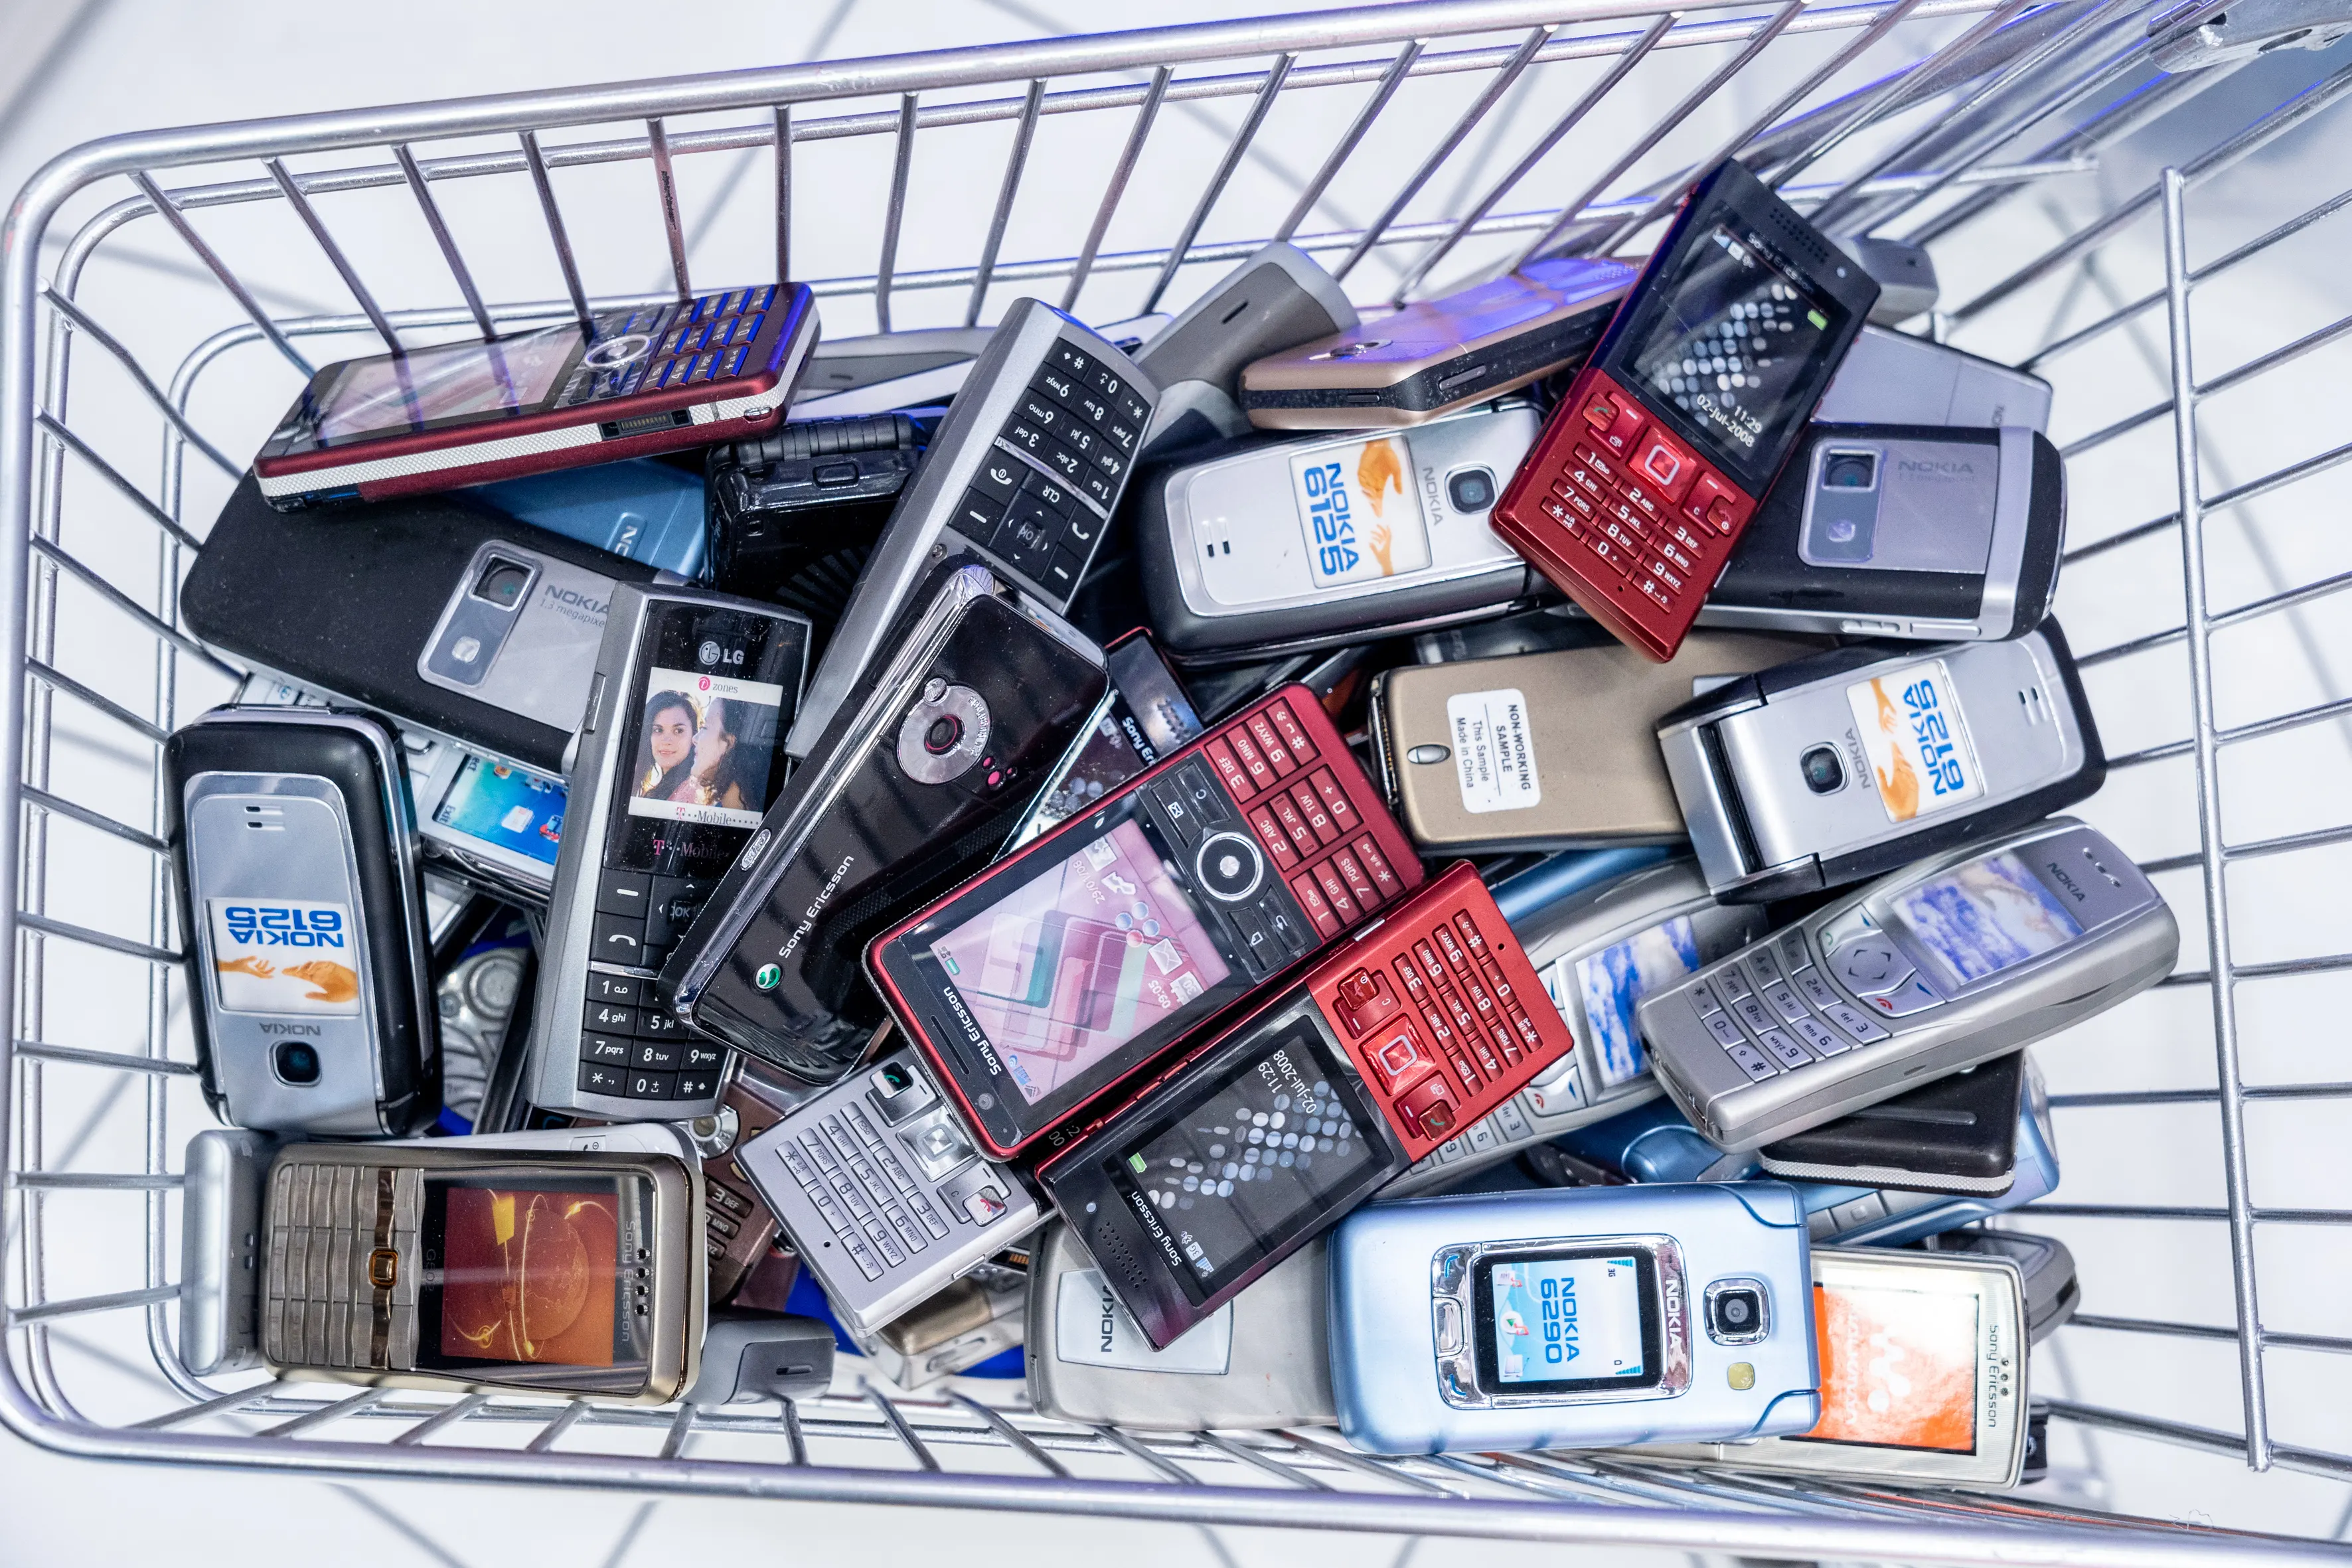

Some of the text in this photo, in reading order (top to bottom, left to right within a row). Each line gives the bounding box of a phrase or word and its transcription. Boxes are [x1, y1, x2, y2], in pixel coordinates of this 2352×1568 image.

[1046, 377, 1070, 397] 9 wxyz
[1029, 404, 1054, 424] 6 mno
[1084, 400, 1104, 420] 8 tuv
[1734, 406, 1763, 433] 11:29
[1015, 426, 1039, 447] 3 def
[1070, 430, 1091, 449] 5 jkl
[1113, 426, 1133, 448] 7 pqrs
[1056, 451, 1078, 473] 2 abc
[1101, 455, 1121, 475] 4 ghi
[1574, 471, 1598, 492] 4 GHI
[1042, 485, 1060, 503] CLR
[1423, 467, 1443, 526] NOKIA
[1563, 486, 1590, 512] 7 PQRS
[1629, 487, 1654, 512] 2 ABC
[1304, 466, 1344, 576] 6125
[1325, 462, 1360, 573] NOKIA
[1618, 505, 1641, 529] 5 JKL
[1607, 524, 1632, 547] 8 TUV
[1674, 526, 1699, 548] 3 DEF
[1664, 543, 1689, 568] 6 MNO
[1653, 562, 1682, 589] 9 WXYZ
[545, 585, 609, 614] NOKIA
[722, 647, 744, 665] LG
[712, 683, 739, 694] zones
[1122, 716, 1144, 750] Sony
[1255, 722, 1285, 763] 9 WXYZ
[1903, 682, 1948, 797] NOKIA
[1917, 678, 1964, 791] 6125
[1237, 739, 1265, 775] 6 MNO
[1456, 717, 1474, 788] Made in China
[1472, 720, 1490, 781] This Sample
[1496, 726, 1512, 772] SAMPLE
[1508, 704, 1531, 790] NON-WORKING
[1845, 727, 1871, 790] NOKIA
[1218, 757, 1245, 789] 3 DEF
[1283, 807, 1307, 840] 5 JKL
[1300, 795, 1326, 828] 8 TUV
[1261, 820, 1287, 854] 2 ABC
[1072, 860, 1106, 905] 29/01/08
[1340, 858, 1370, 898] 7 PQRS
[2046, 862, 2086, 902] NOKIA
[1325, 878, 1349, 909] 4 GHI
[224, 905, 343, 930] 6125
[779, 854, 854, 959] Sony Ericsson
[228, 929, 345, 948] NOKIA
[1441, 931, 1455, 951] WXYZ
[1423, 949, 1435, 966] MNO
[1403, 966, 1415, 979] DEF
[1148, 980, 1172, 1009] 09:05
[1472, 985, 1484, 1000] TUV
[598, 1008, 627, 1023] 4 ghi
[1452, 999, 1463, 1012] JKL
[260, 1022, 321, 1037] NOKIA
[651, 1015, 674, 1030] 5 jkl
[943, 986, 1002, 1075] Sony Ericsson
[1430, 1013, 1443, 1028] ABC
[595, 1040, 624, 1056] 7 pqrs
[1496, 1028, 1510, 1046] PQRS
[643, 1048, 653, 1061] 8
[690, 1050, 716, 1063] 9 wxyz
[1479, 1046, 1490, 1059] GHI
[1258, 1062, 1282, 1093] 11:29
[836, 1135, 849, 1148] GHI
[815, 1148, 830, 1166] PQRS
[891, 1166, 905, 1181] ABC
[869, 1180, 882, 1194] JKL
[848, 1193, 861, 1208] TUV
[925, 1214, 939, 1227] DEF
[1131, 1191, 1182, 1266] Sony Ericsson
[903, 1226, 917, 1242] MNO
[882, 1241, 898, 1260] WXYZ
[621, 1220, 635, 1342] Sony Ericsson
[1608, 1268, 1616, 1277] 3G
[1540, 1279, 1563, 1364] 6290
[1561, 1277, 1580, 1362] NOKIA
[1665, 1279, 1682, 1350] NOKIA
[1987, 1325, 1999, 1427] Sony Ericsson
